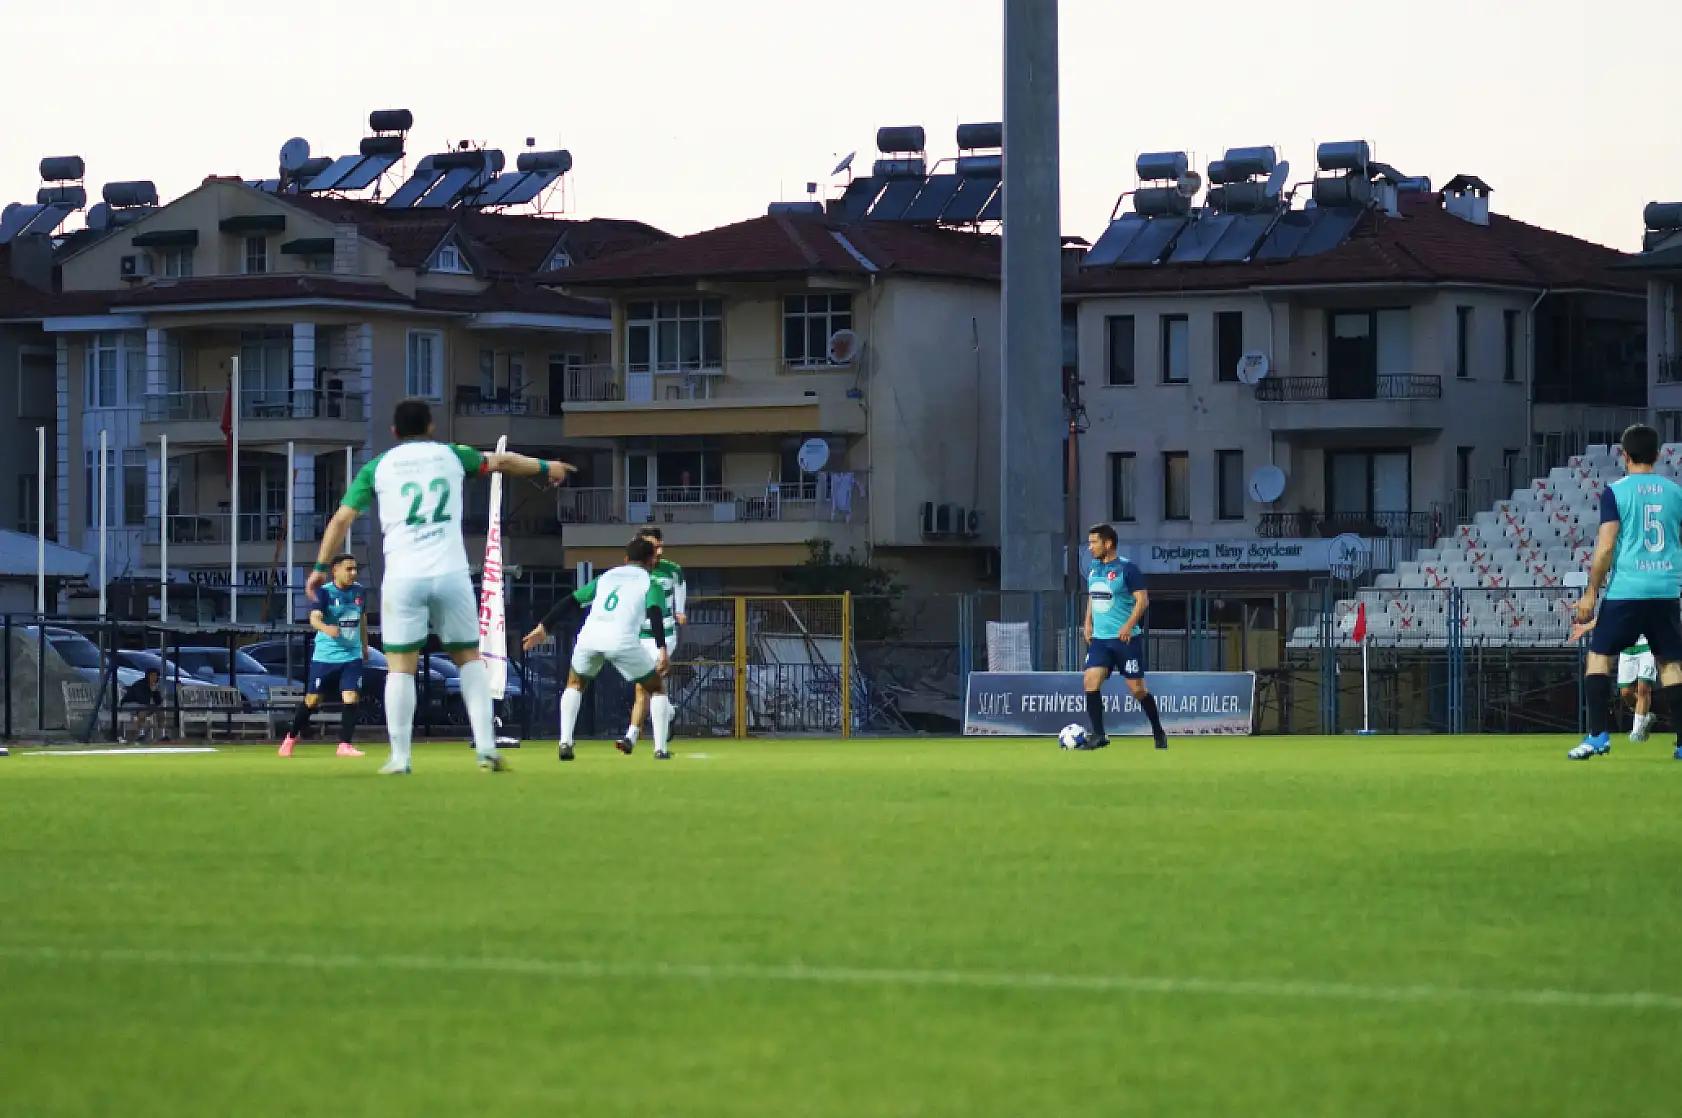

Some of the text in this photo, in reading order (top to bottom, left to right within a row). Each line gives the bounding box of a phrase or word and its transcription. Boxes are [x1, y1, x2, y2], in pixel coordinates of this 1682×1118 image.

[400, 477, 452, 525] 22
[1644, 504, 1665, 552] 5
[604, 584, 620, 611] 6
